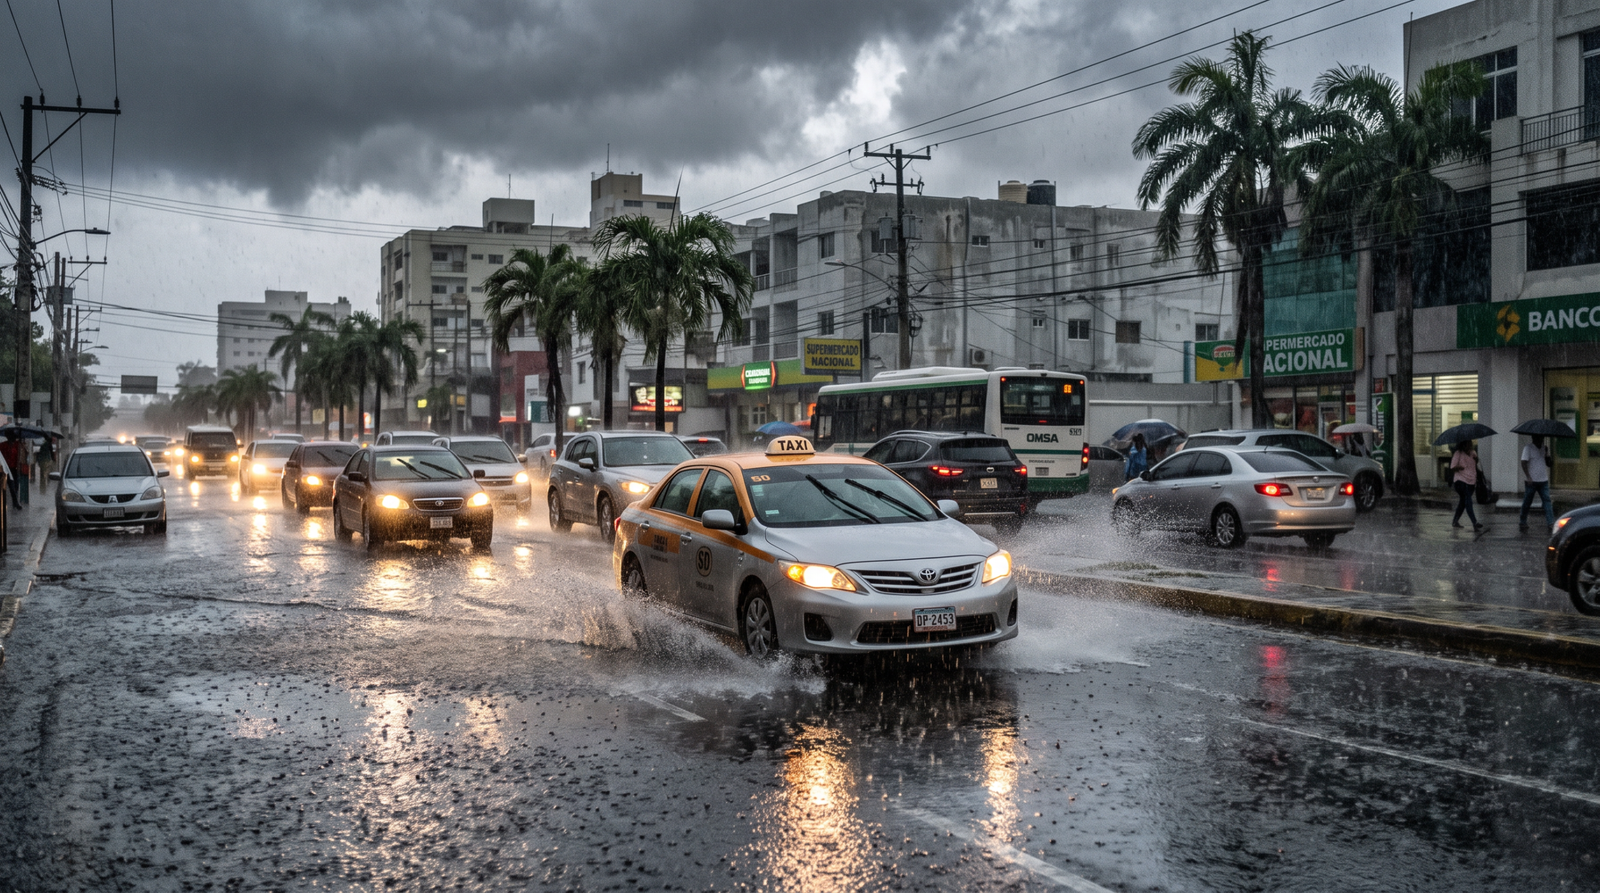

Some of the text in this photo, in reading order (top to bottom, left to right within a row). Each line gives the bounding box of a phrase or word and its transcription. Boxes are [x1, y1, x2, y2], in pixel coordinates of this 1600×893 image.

[1528, 306, 1600, 332] BANCO
[1264, 332, 1345, 351] PERMERCADO
[806, 343, 859, 356] SUPERMERCADO
[811, 356, 855, 367] NACIONAL
[1263, 348, 1348, 373] ACIONAL
[1026, 433, 1059, 443] OMSA
[777, 440, 808, 451] TAXI
[916, 613, 954, 627] DP-2453
